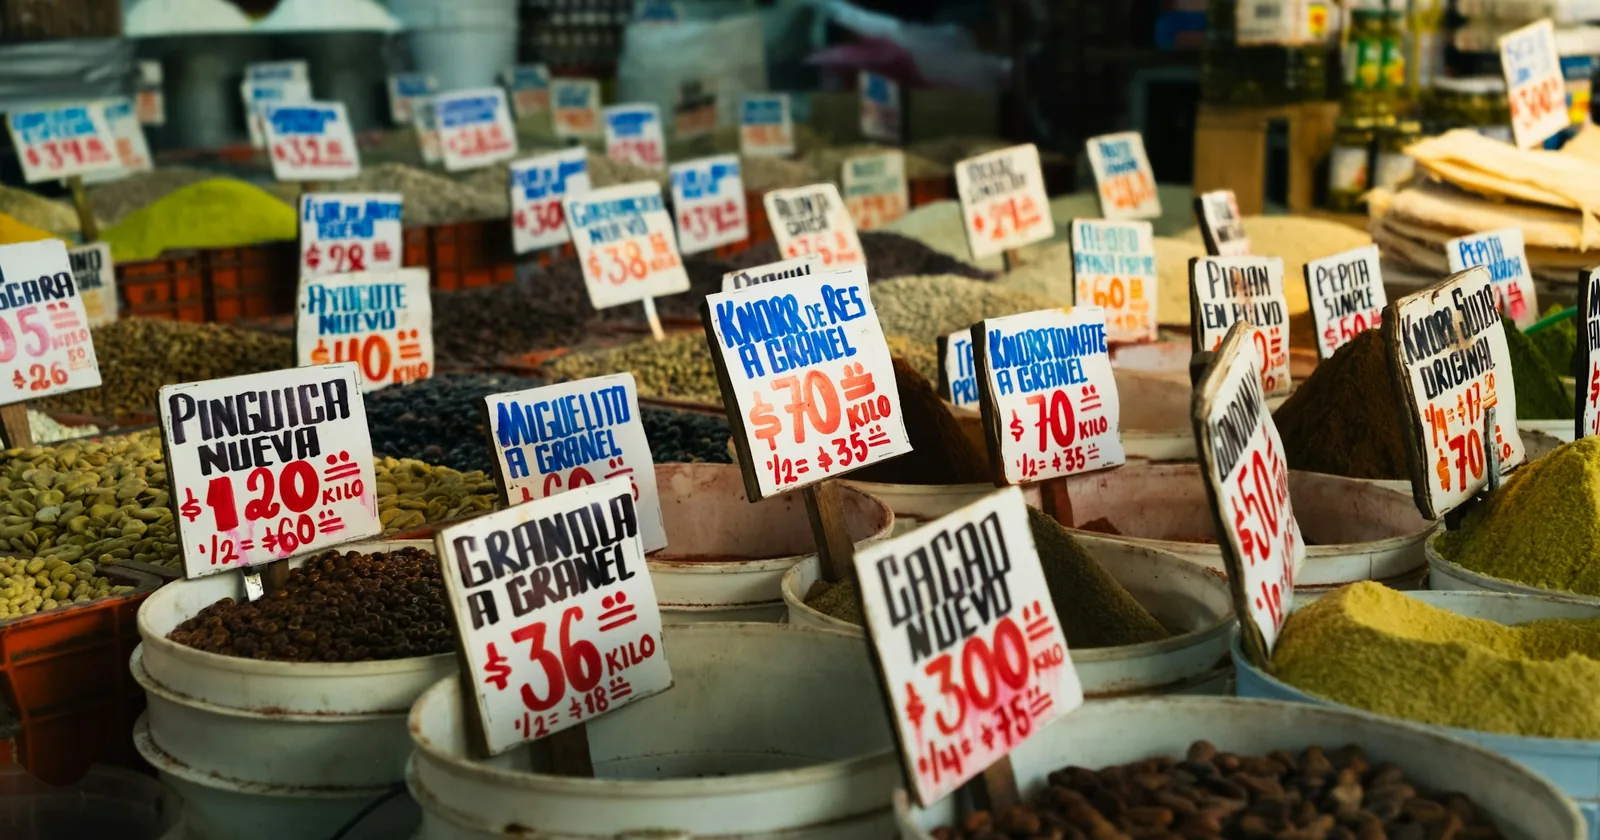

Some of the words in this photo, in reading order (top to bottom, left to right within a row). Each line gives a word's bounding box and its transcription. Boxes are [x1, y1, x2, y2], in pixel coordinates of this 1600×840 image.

[587, 240, 648, 284] $38
[1316, 259, 1370, 297] PEPITA
[318, 309, 396, 335] NUEVO
[716, 293, 807, 348] KNORR
[805, 302, 827, 328] DE
[821, 284, 866, 325] RES
[1203, 303, 1228, 329] EN
[1323, 286, 1373, 320] SIMPLE
[1401, 306, 1459, 366] KNORR
[1452, 283, 1500, 334] SUIZA
[738, 343, 765, 379] A
[765, 325, 857, 374] GRANEL
[996, 367, 1014, 396] A
[1017, 358, 1088, 393] GRANEL
[1420, 336, 1496, 400] ORIGINAL
[168, 378, 350, 445] PINGUICA
[496, 385, 631, 448] MIGUELITO
[749, 369, 841, 451] $70
[846, 395, 891, 431] KILO
[1010, 389, 1076, 453] $70
[1078, 416, 1108, 440] KILO
[197, 425, 321, 476] NUEVA
[505, 447, 530, 479] A
[534, 429, 623, 475] GRANEL
[1436, 428, 1484, 492] $70
[180, 459, 319, 532] $120
[322, 479, 364, 506] KILO
[453, 493, 638, 589] GRANOLA
[876, 511, 1011, 628] CACAO
[466, 590, 499, 630] A
[506, 543, 635, 618] GRANEL
[906, 570, 1013, 664] NUEVO
[484, 606, 603, 712] $36
[605, 633, 655, 676] KILO
[905, 616, 1030, 736] $300
